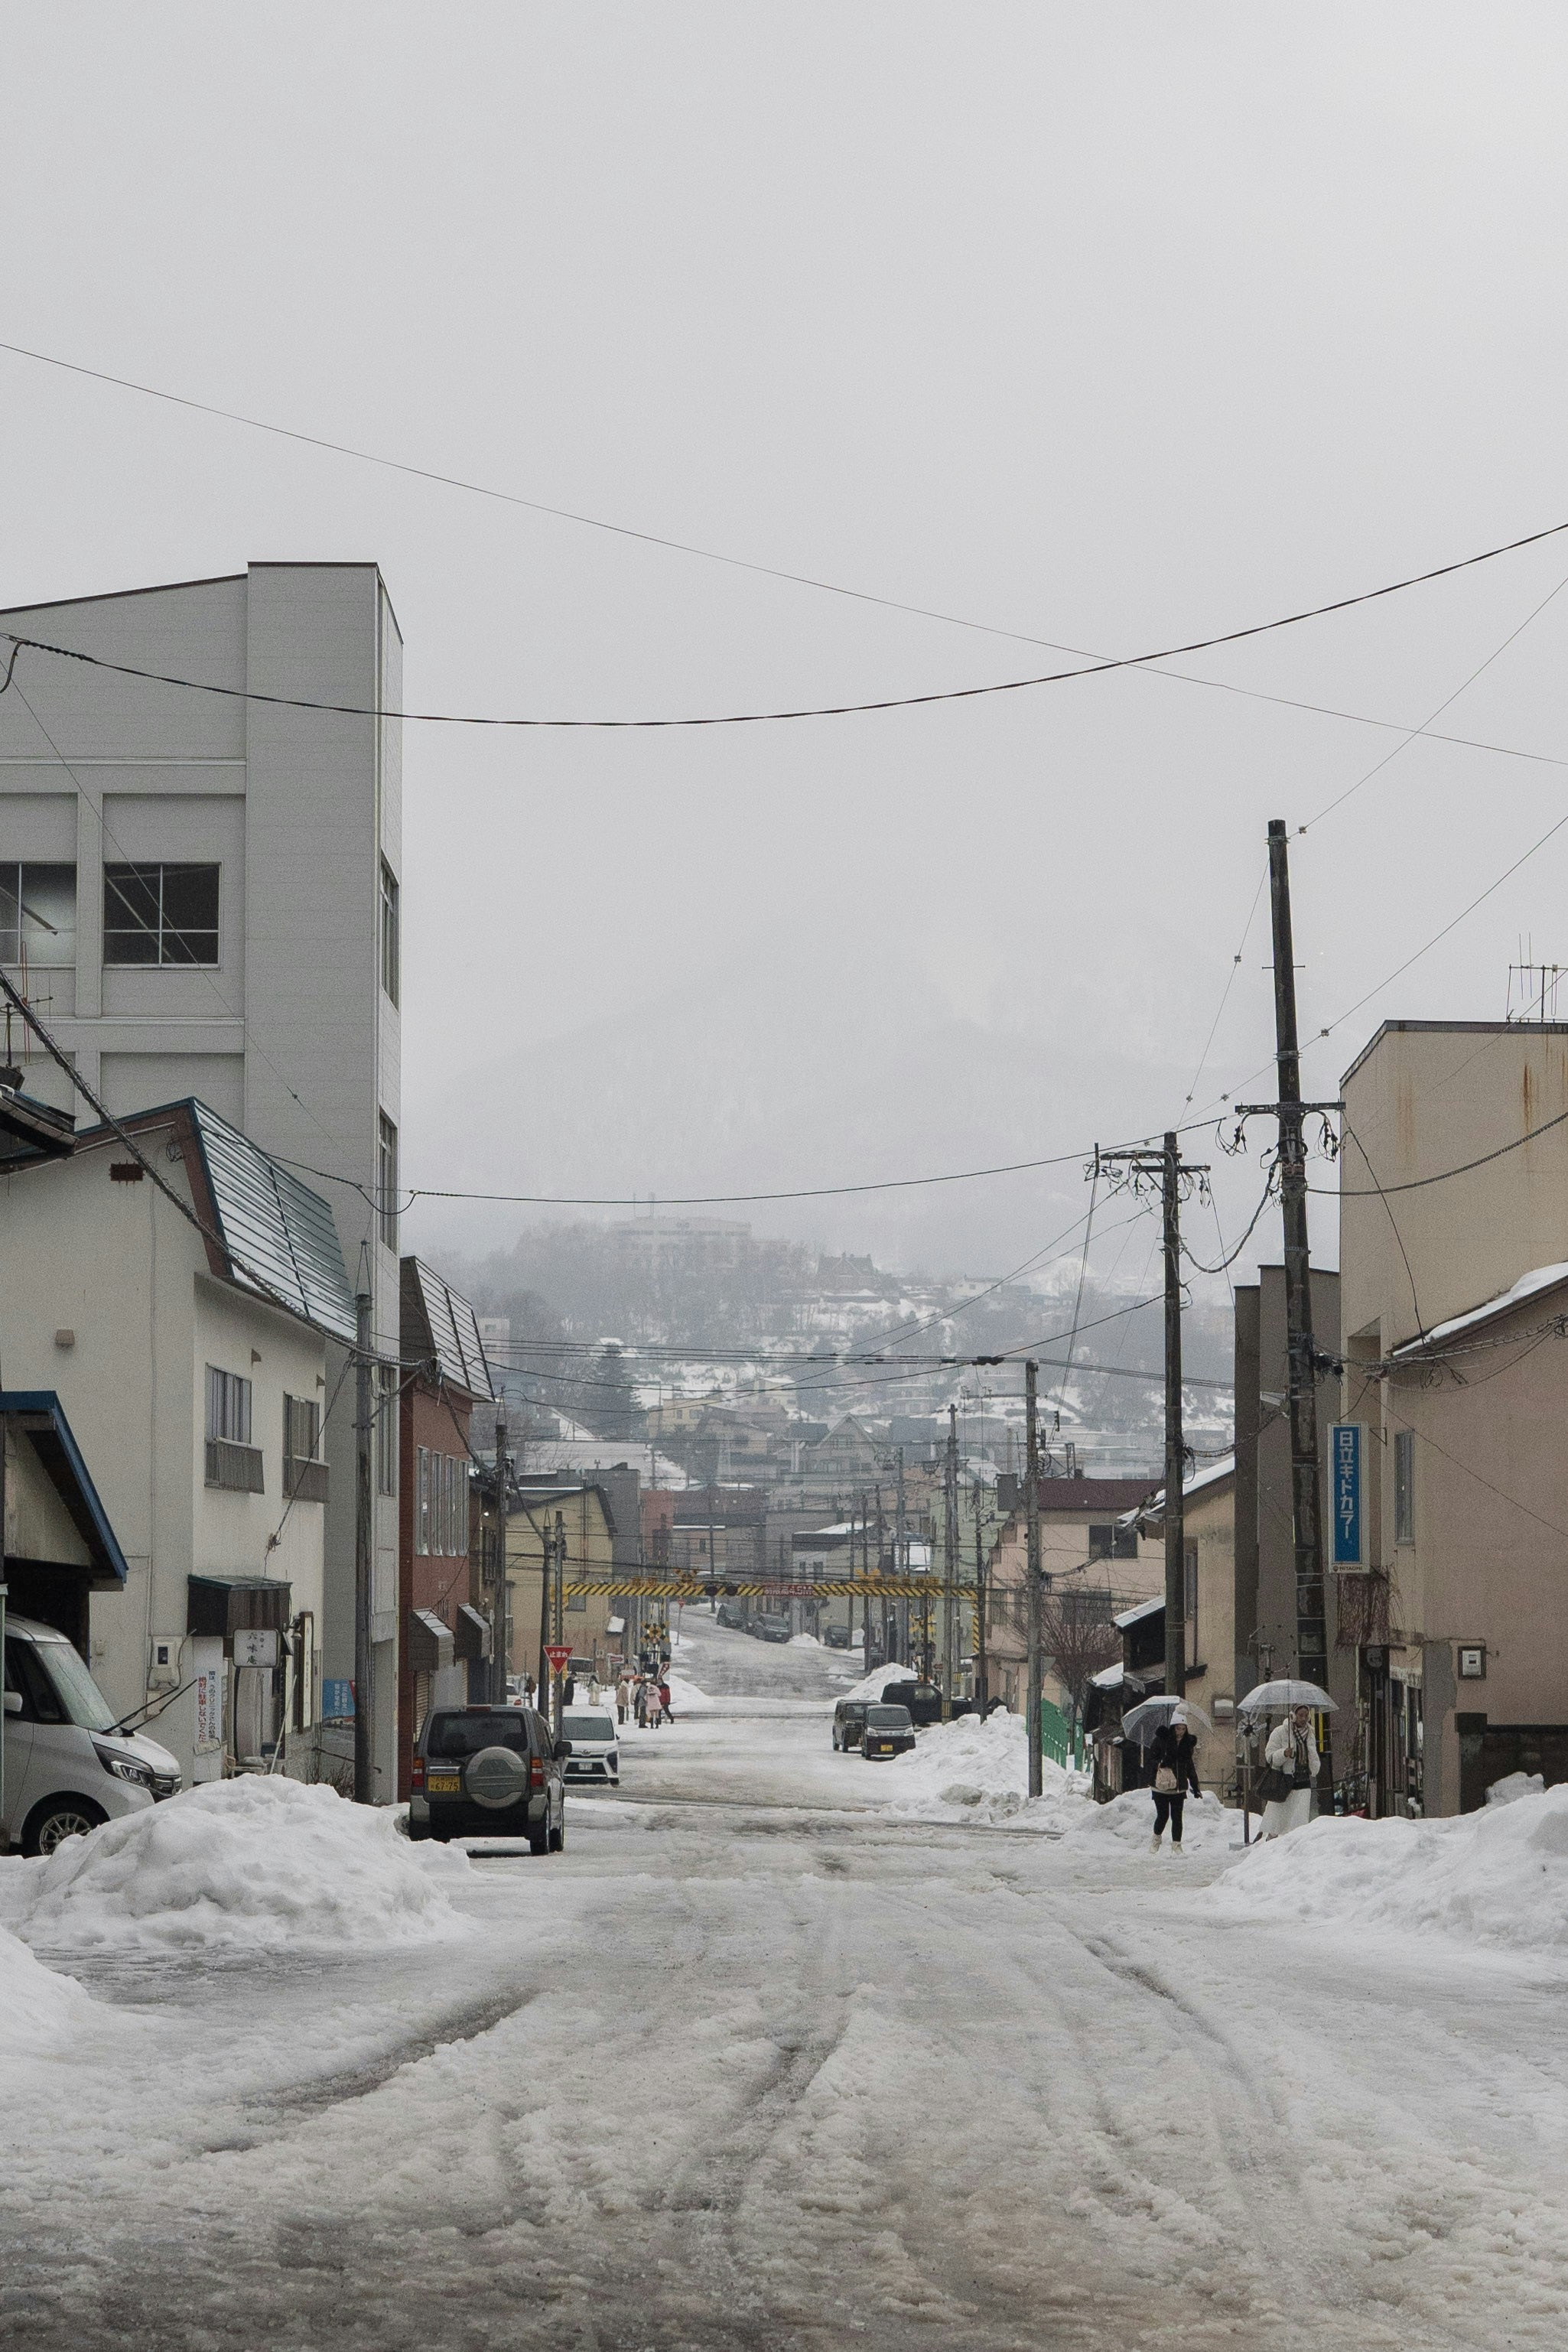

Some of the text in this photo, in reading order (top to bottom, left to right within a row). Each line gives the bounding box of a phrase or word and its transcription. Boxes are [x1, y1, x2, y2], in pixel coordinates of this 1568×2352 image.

[1339, 1431, 1354, 1539] 日立キドカラー
